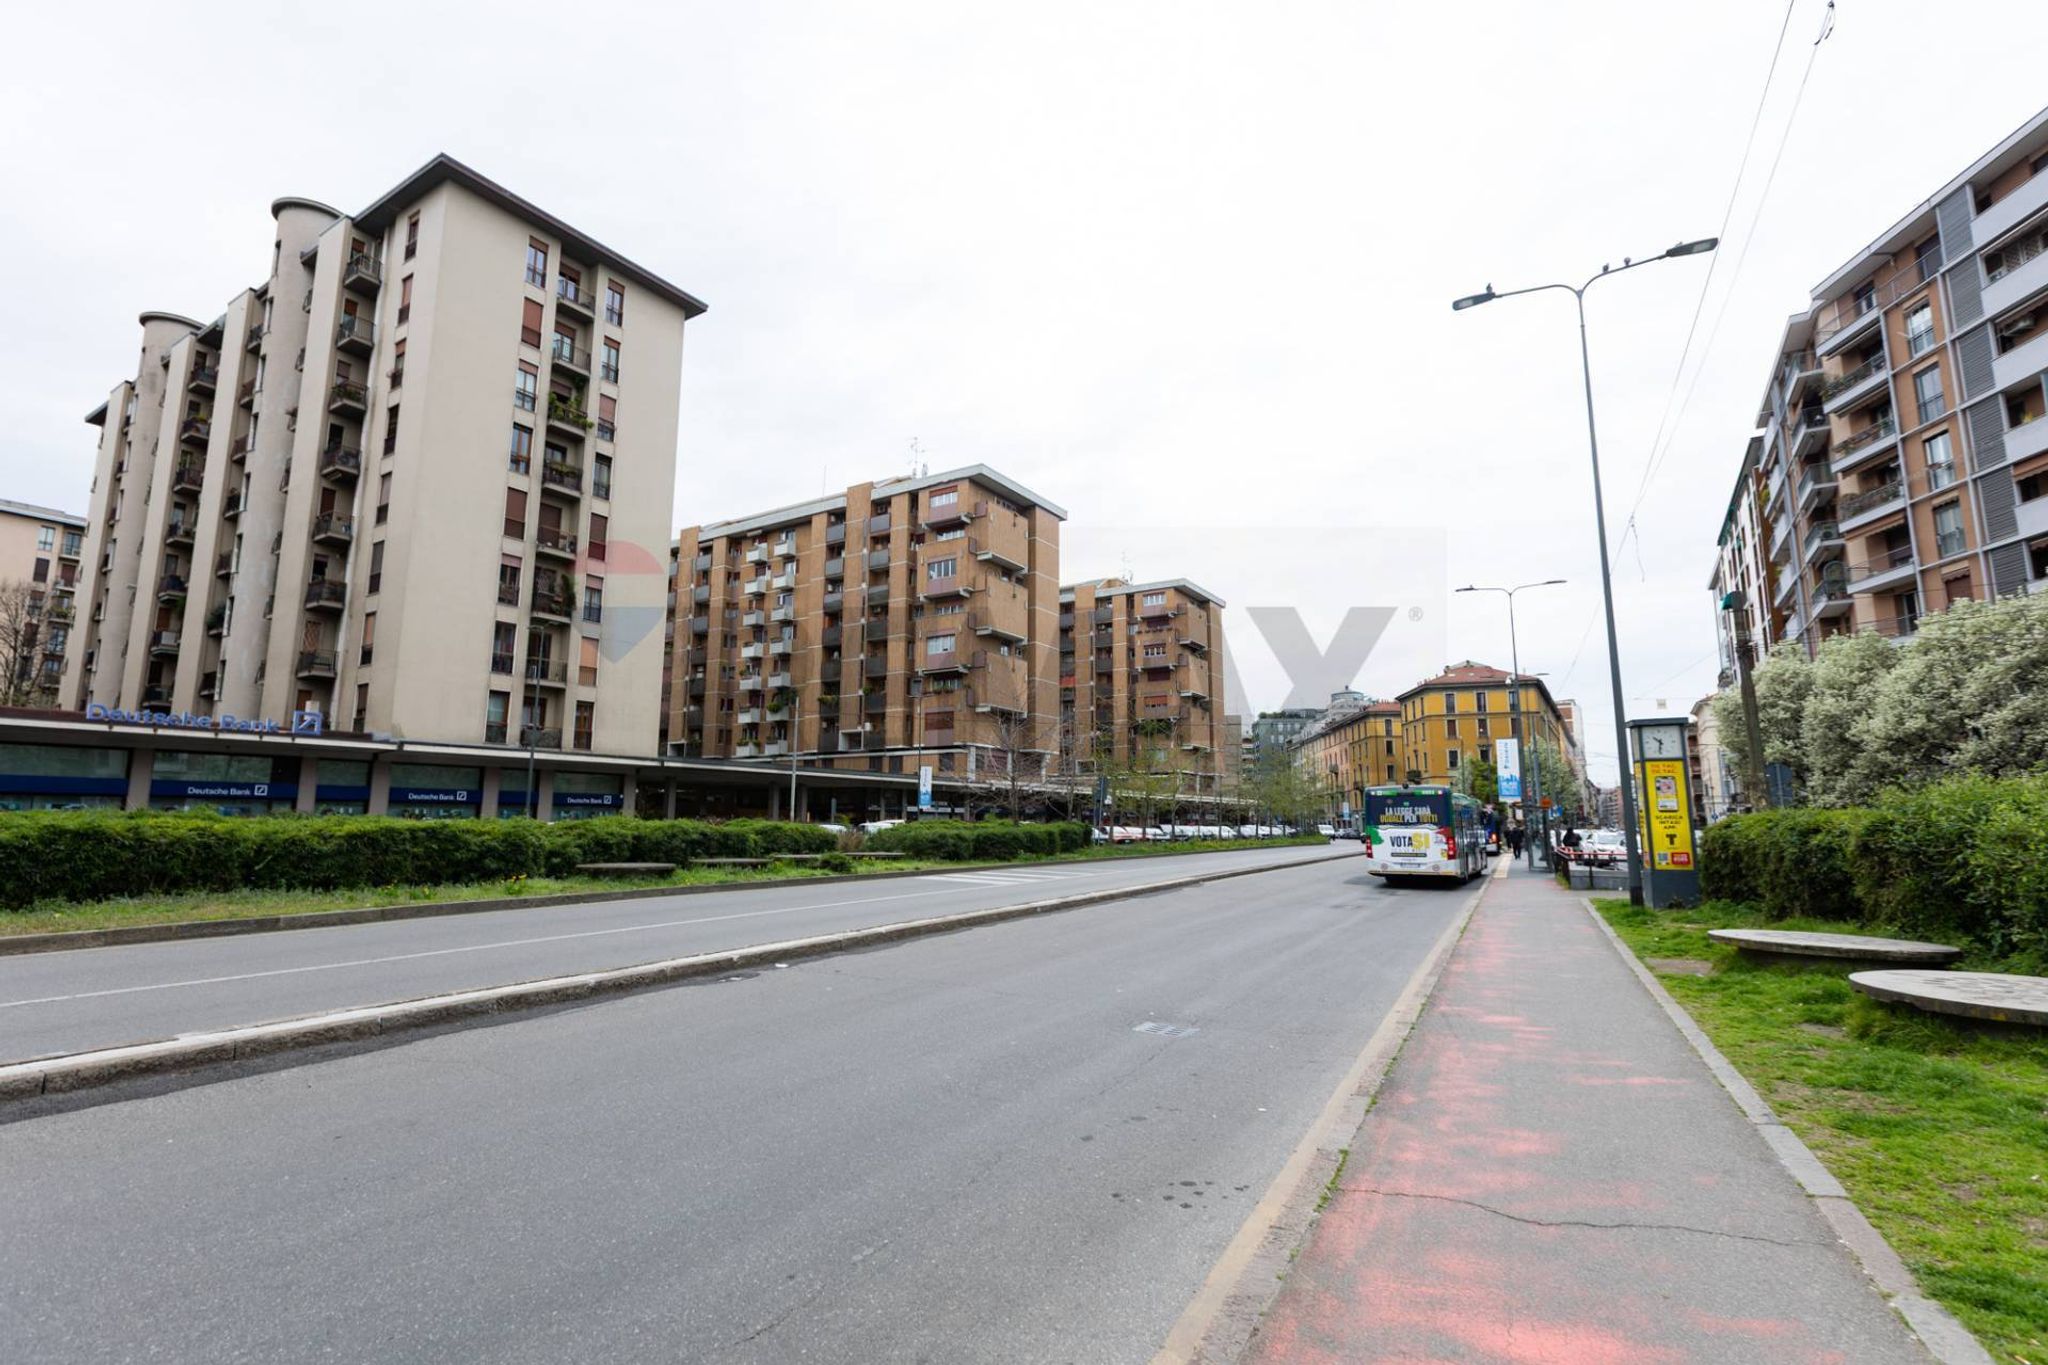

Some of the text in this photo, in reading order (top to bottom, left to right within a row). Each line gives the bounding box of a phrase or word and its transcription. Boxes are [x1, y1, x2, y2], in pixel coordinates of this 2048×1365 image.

[86, 703, 281, 733] Deutsche Bank
[187, 786, 251, 796] Deutsche Bank
[408, 792, 454, 801] Deutsche Bank
[567, 796, 589, 804] Deutsche
[1390, 836, 1413, 847] VOTA
